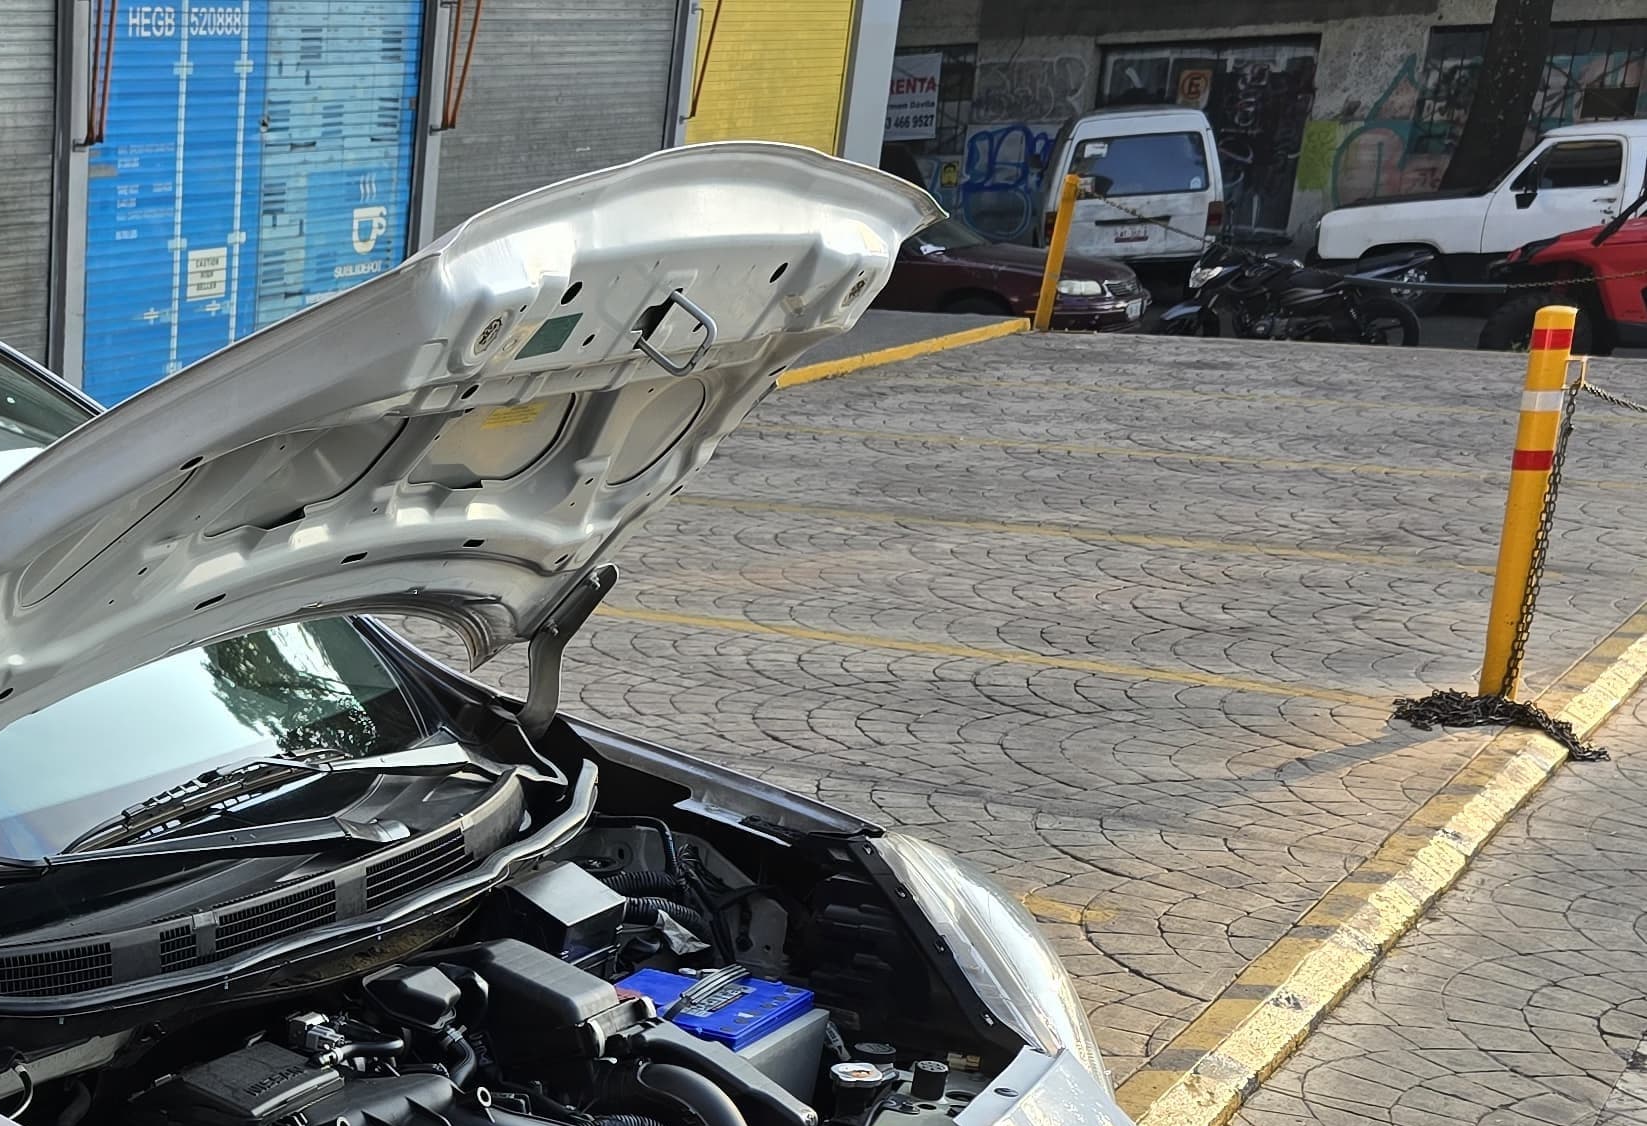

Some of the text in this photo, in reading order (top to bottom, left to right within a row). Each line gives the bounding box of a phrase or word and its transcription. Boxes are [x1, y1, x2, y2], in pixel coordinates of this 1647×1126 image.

[127, 6, 242, 38] HEGB 520888
[242, 1065, 307, 1097] NISSAN
